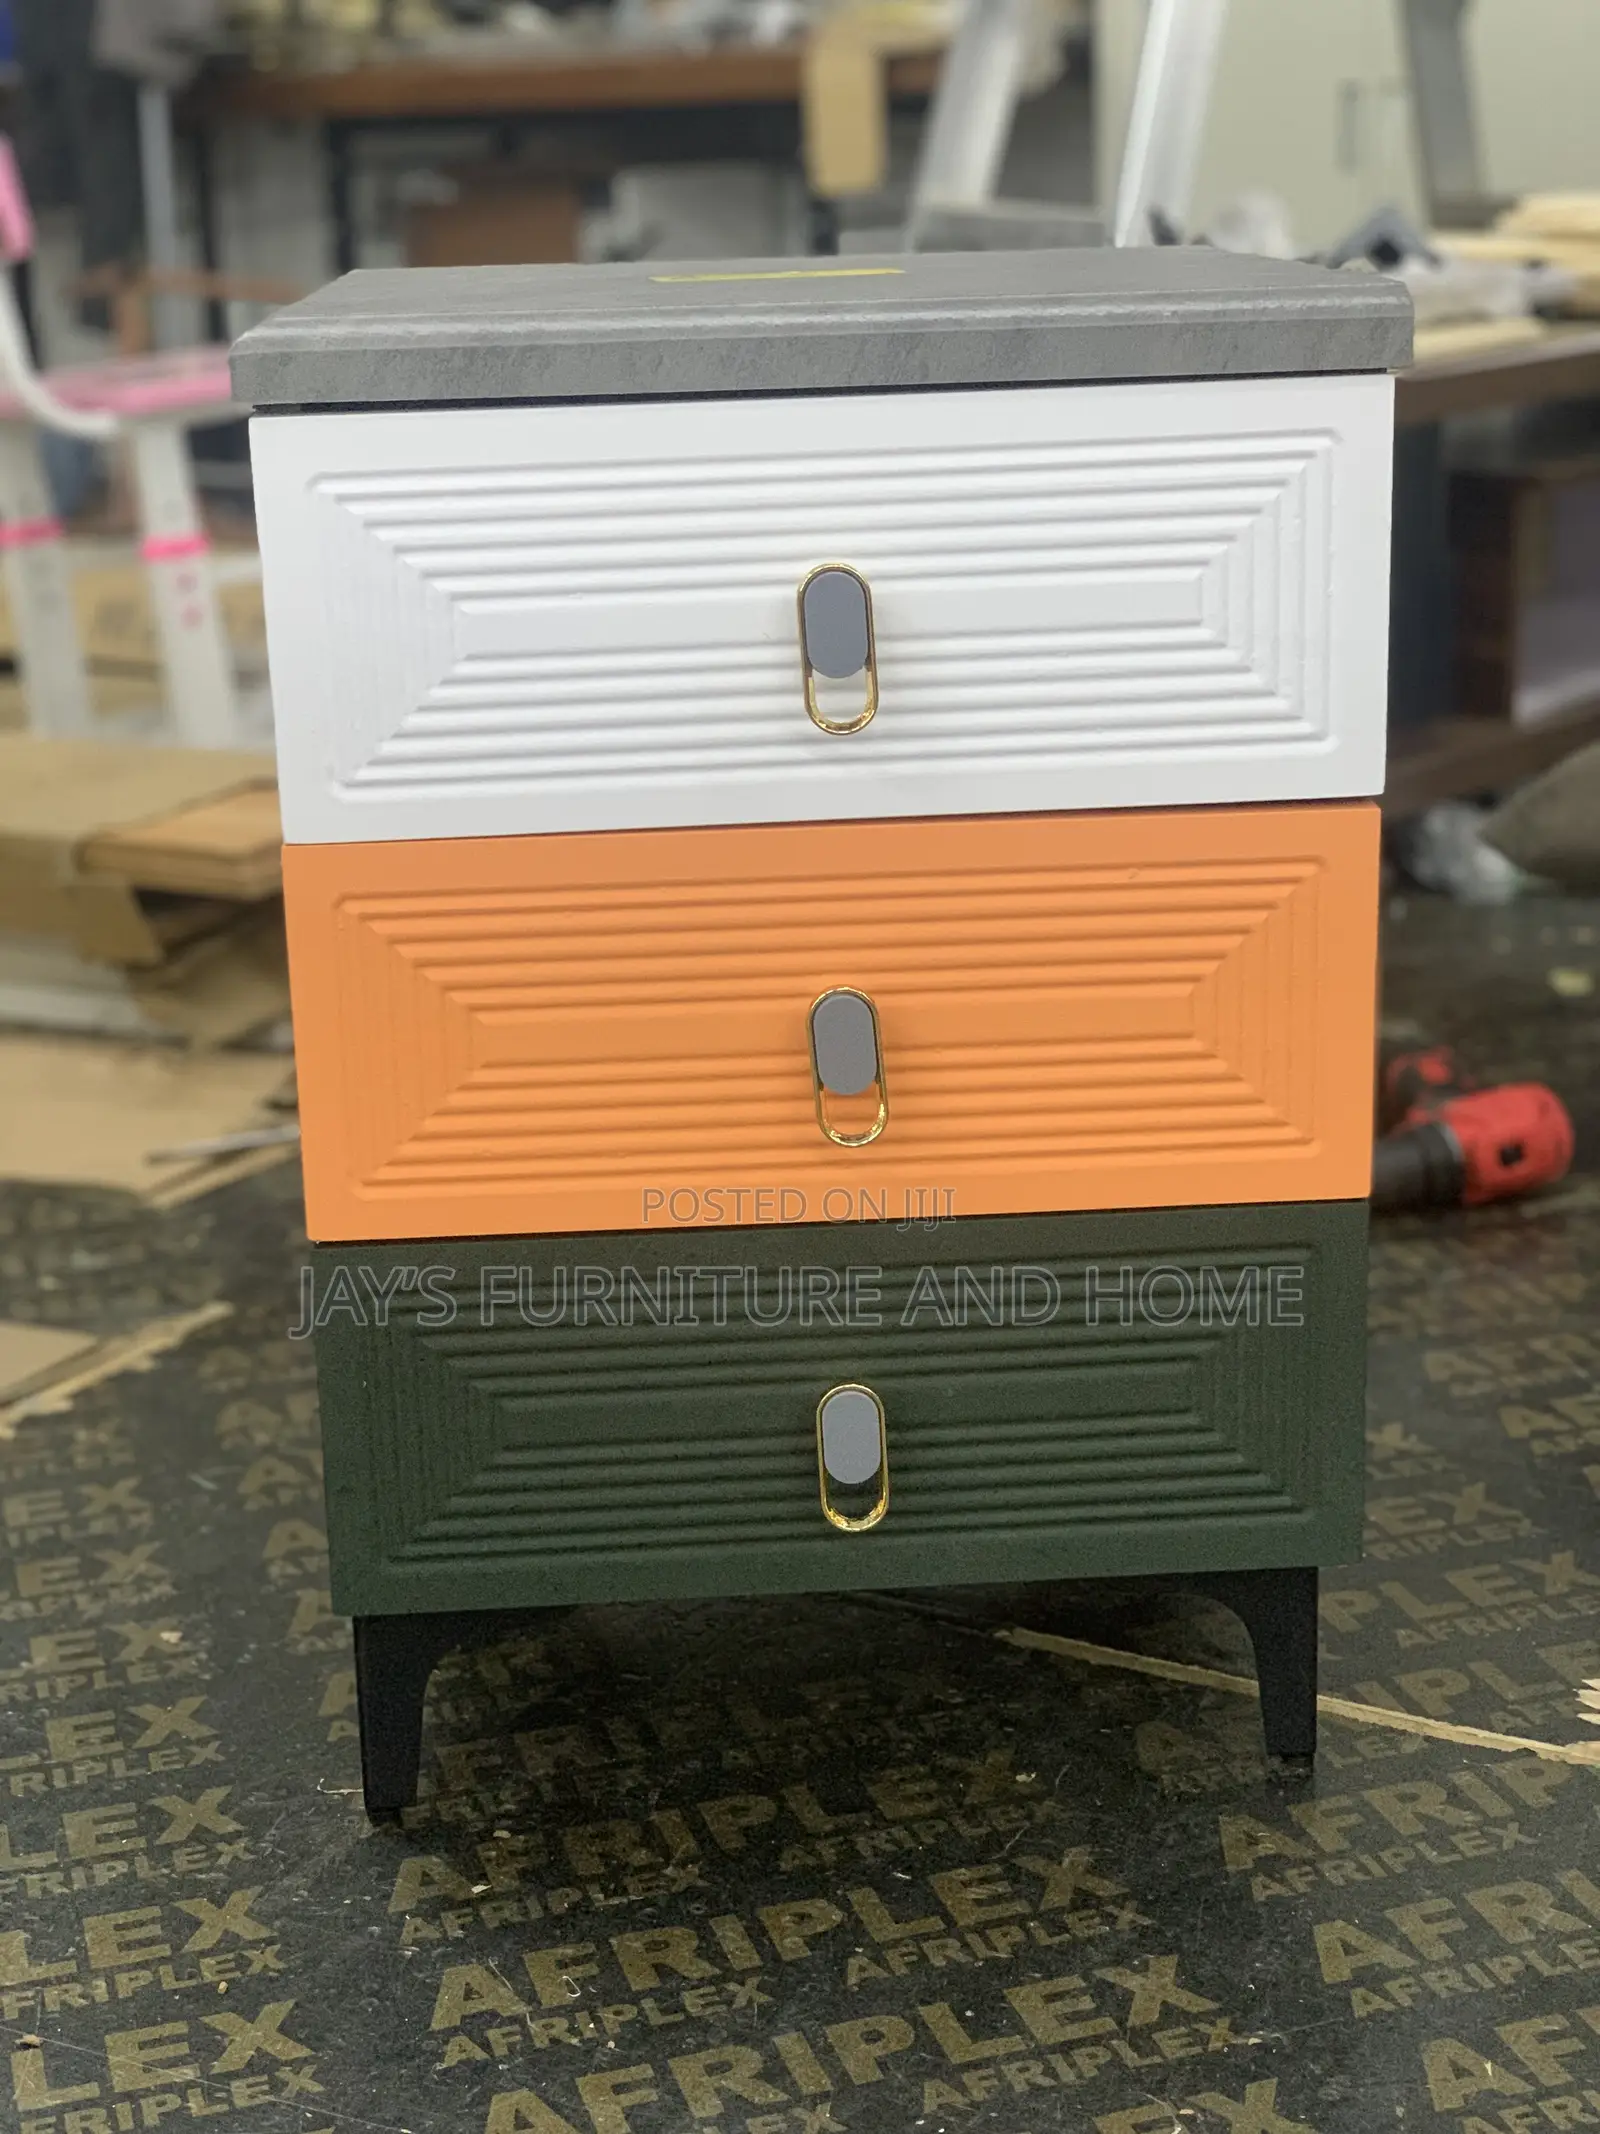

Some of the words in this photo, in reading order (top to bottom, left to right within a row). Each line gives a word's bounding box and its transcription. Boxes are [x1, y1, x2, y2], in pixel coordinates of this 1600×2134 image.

[429, 1844, 1131, 2032] AFRIPLEX
[846, 1900, 1158, 1992] AFRIPLEX
[437, 1976, 774, 2071] AFRIPLEX
[922, 2016, 1240, 2114] AFRIPLEX
